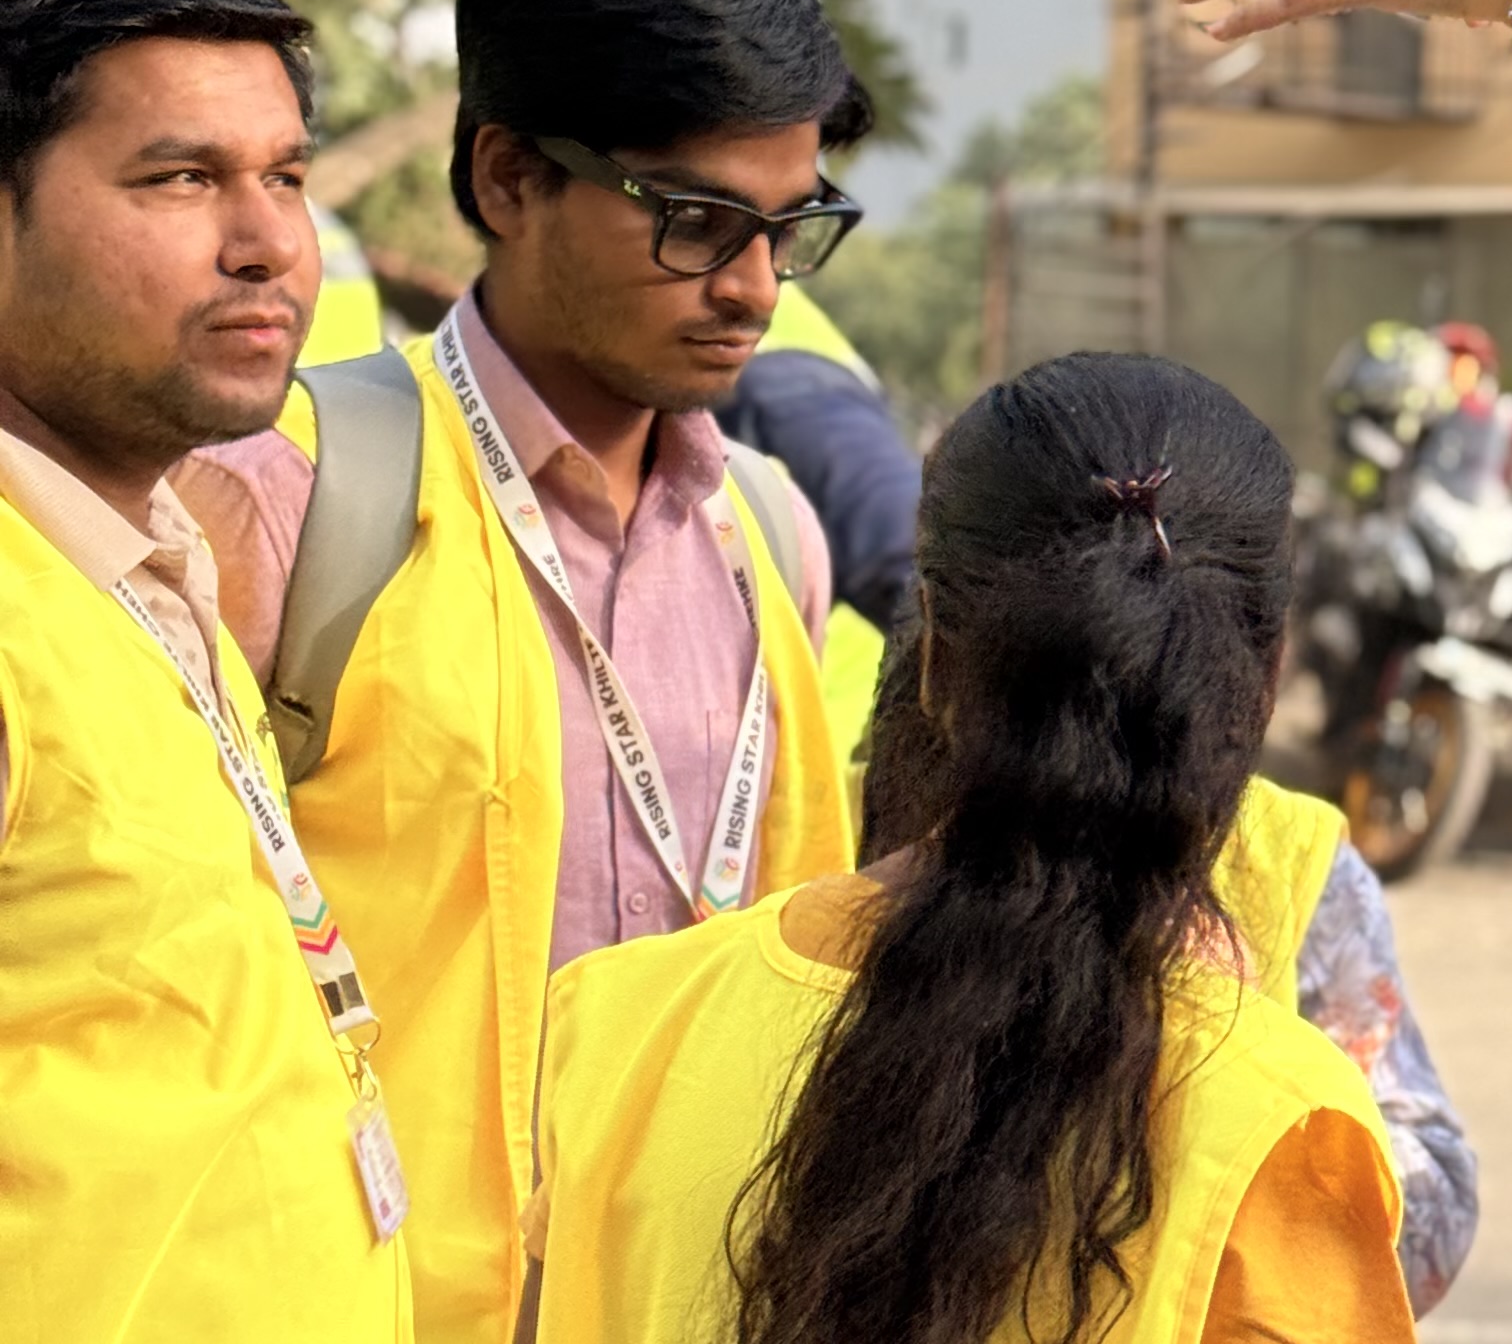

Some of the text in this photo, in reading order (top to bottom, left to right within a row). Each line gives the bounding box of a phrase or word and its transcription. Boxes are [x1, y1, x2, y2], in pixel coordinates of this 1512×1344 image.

[450, 367, 479, 416] STAR
[472, 416, 516, 485] RISING
[210, 715, 244, 774] STAR
[608, 709, 645, 768] STAR
[242, 775, 286, 853] RISING
[635, 771, 672, 841] RISING
[723, 778, 753, 850] RISING
[740, 722, 762, 775] STAR
